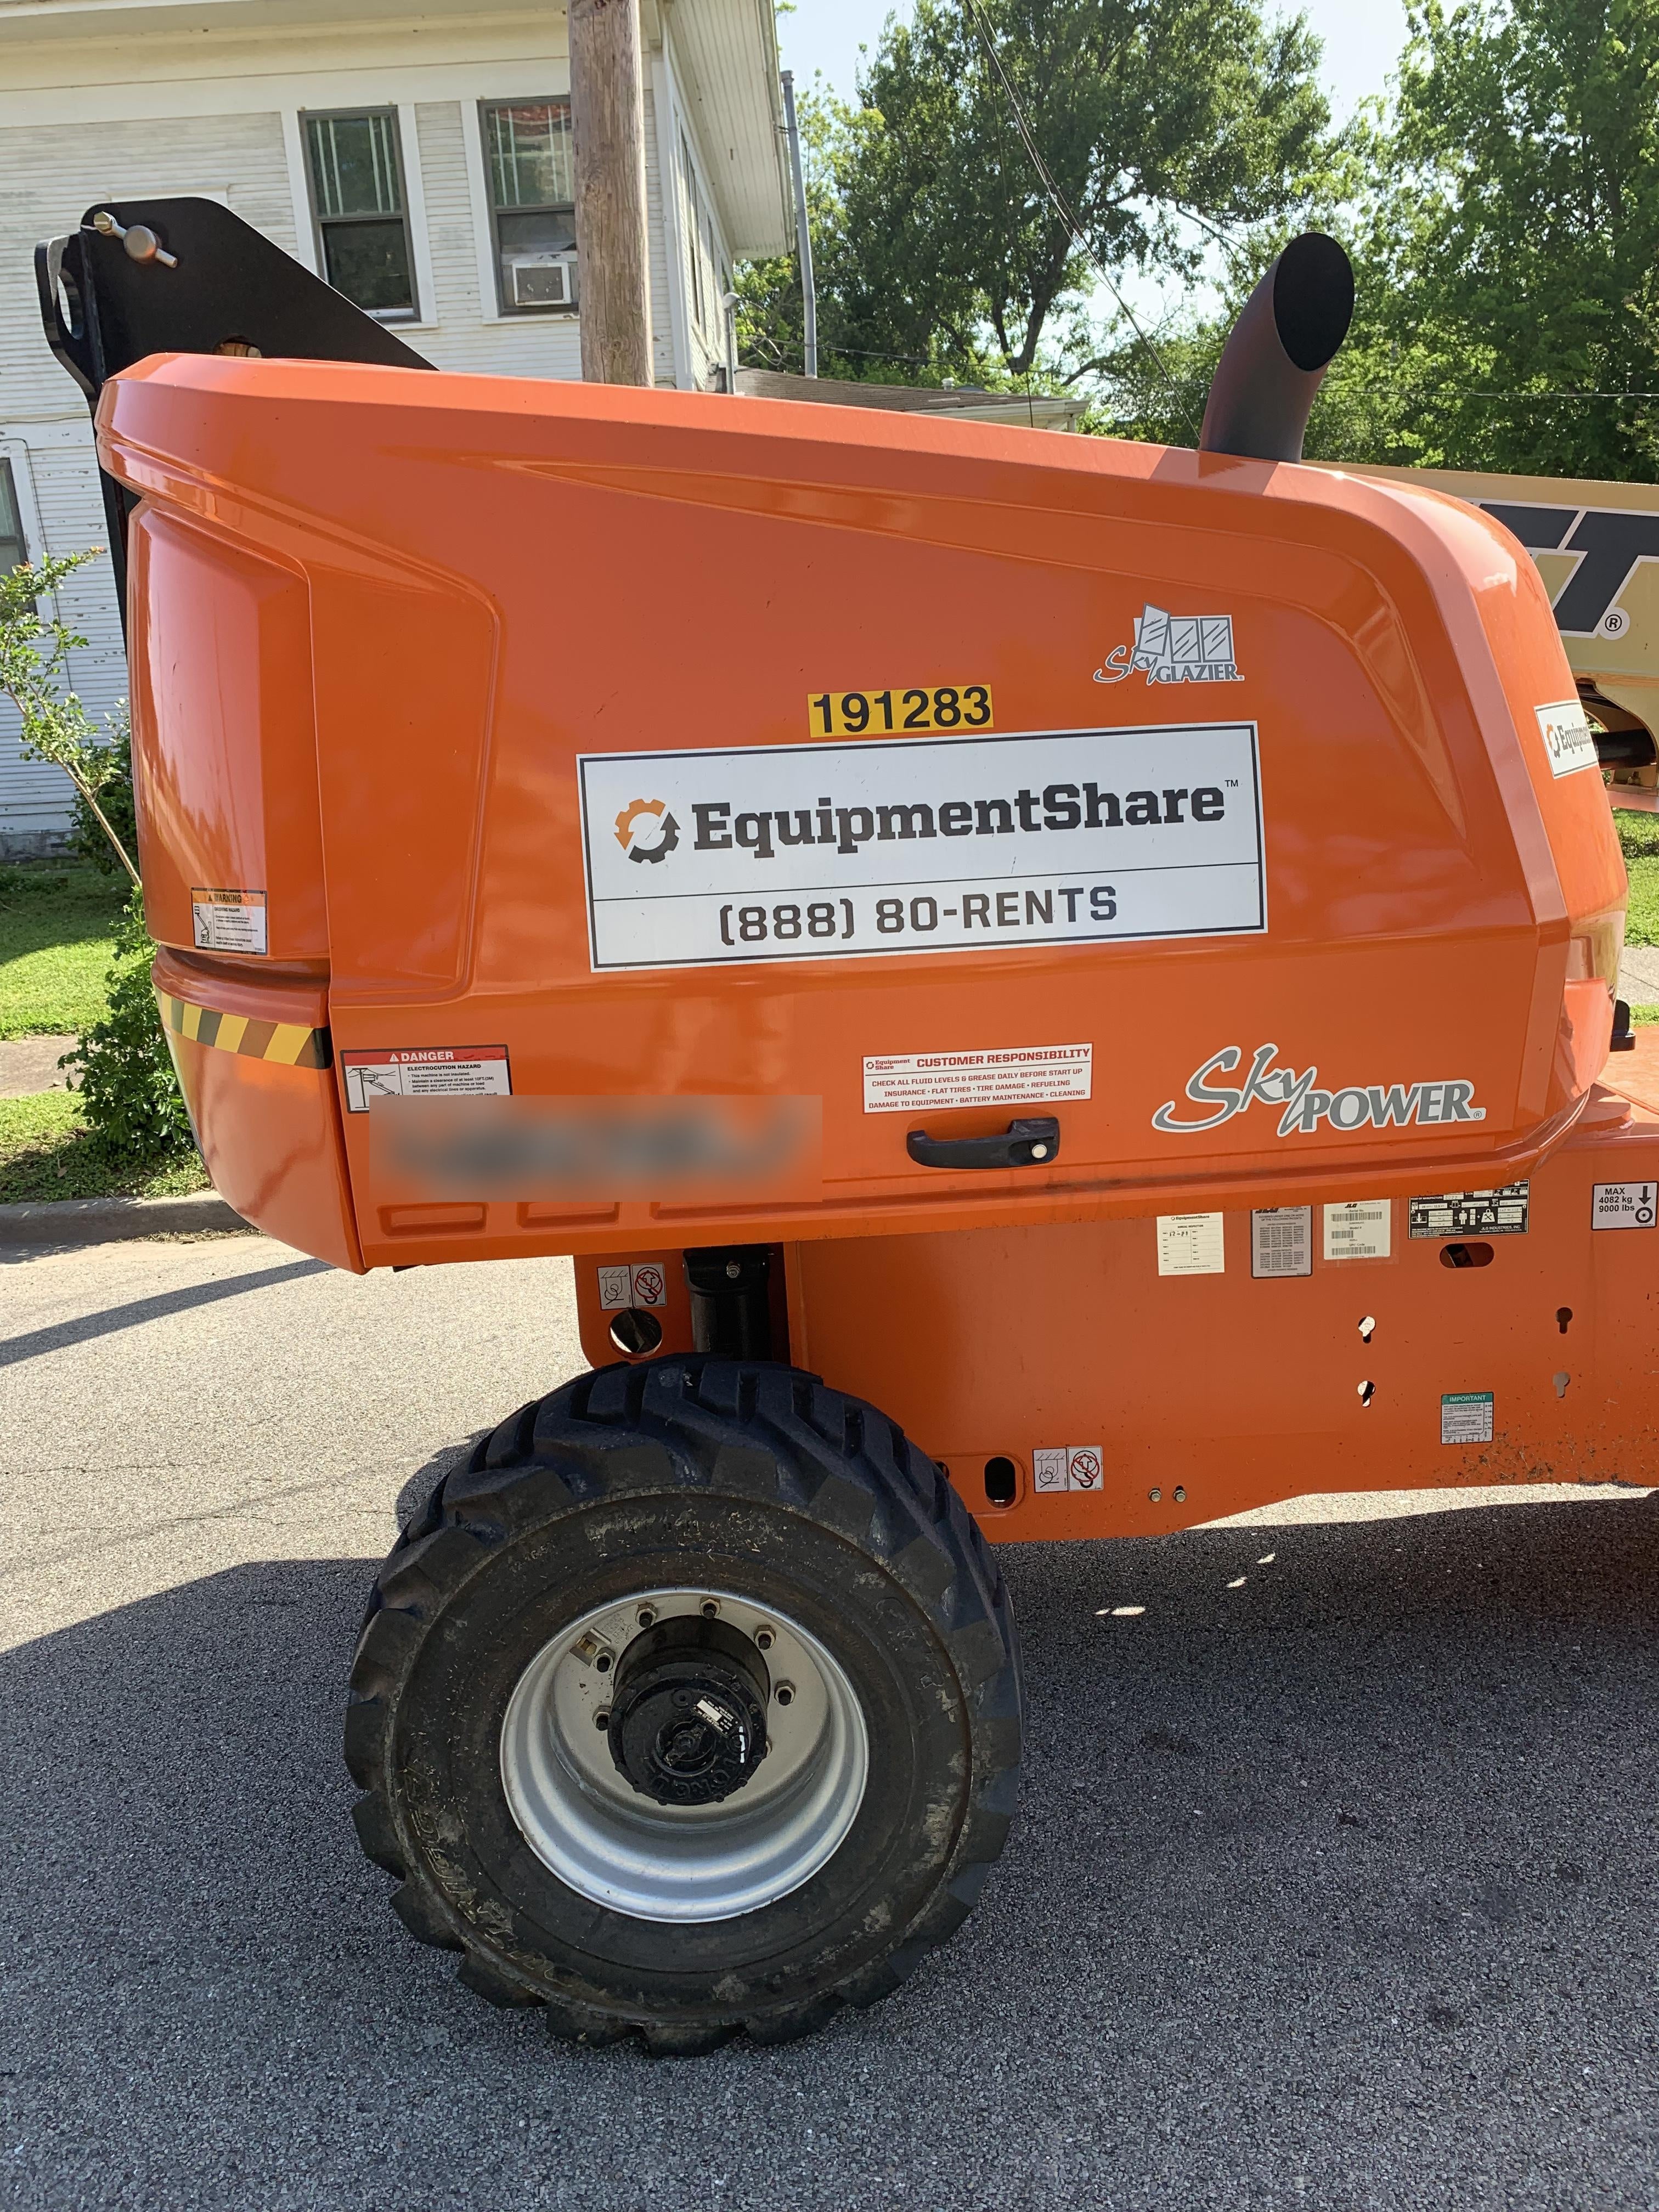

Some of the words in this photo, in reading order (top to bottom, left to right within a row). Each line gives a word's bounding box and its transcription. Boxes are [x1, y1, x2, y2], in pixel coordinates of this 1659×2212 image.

[812, 687, 991, 734] 191283
[692, 781, 1225, 858] EquipmentShare
[214, 893, 242, 904] WARNING
[720, 898, 856, 946] (888)
[877, 885, 1118, 935] 80-RENTS
[401, 1051, 454, 1062] DANGER
[917, 1055, 984, 1068] CUSTOMER
[988, 1048, 1090, 1063] RESPONSIBILITY
[884, 1089, 926, 1097] INSURANCE
[1031, 1080, 1070, 1088] REFUELING
[912, 1098, 955, 1106] EQUIPMENT
[992, 1092, 1045, 1101] MAINTENANCE
[1622, 1195, 1632, 1204] kg
